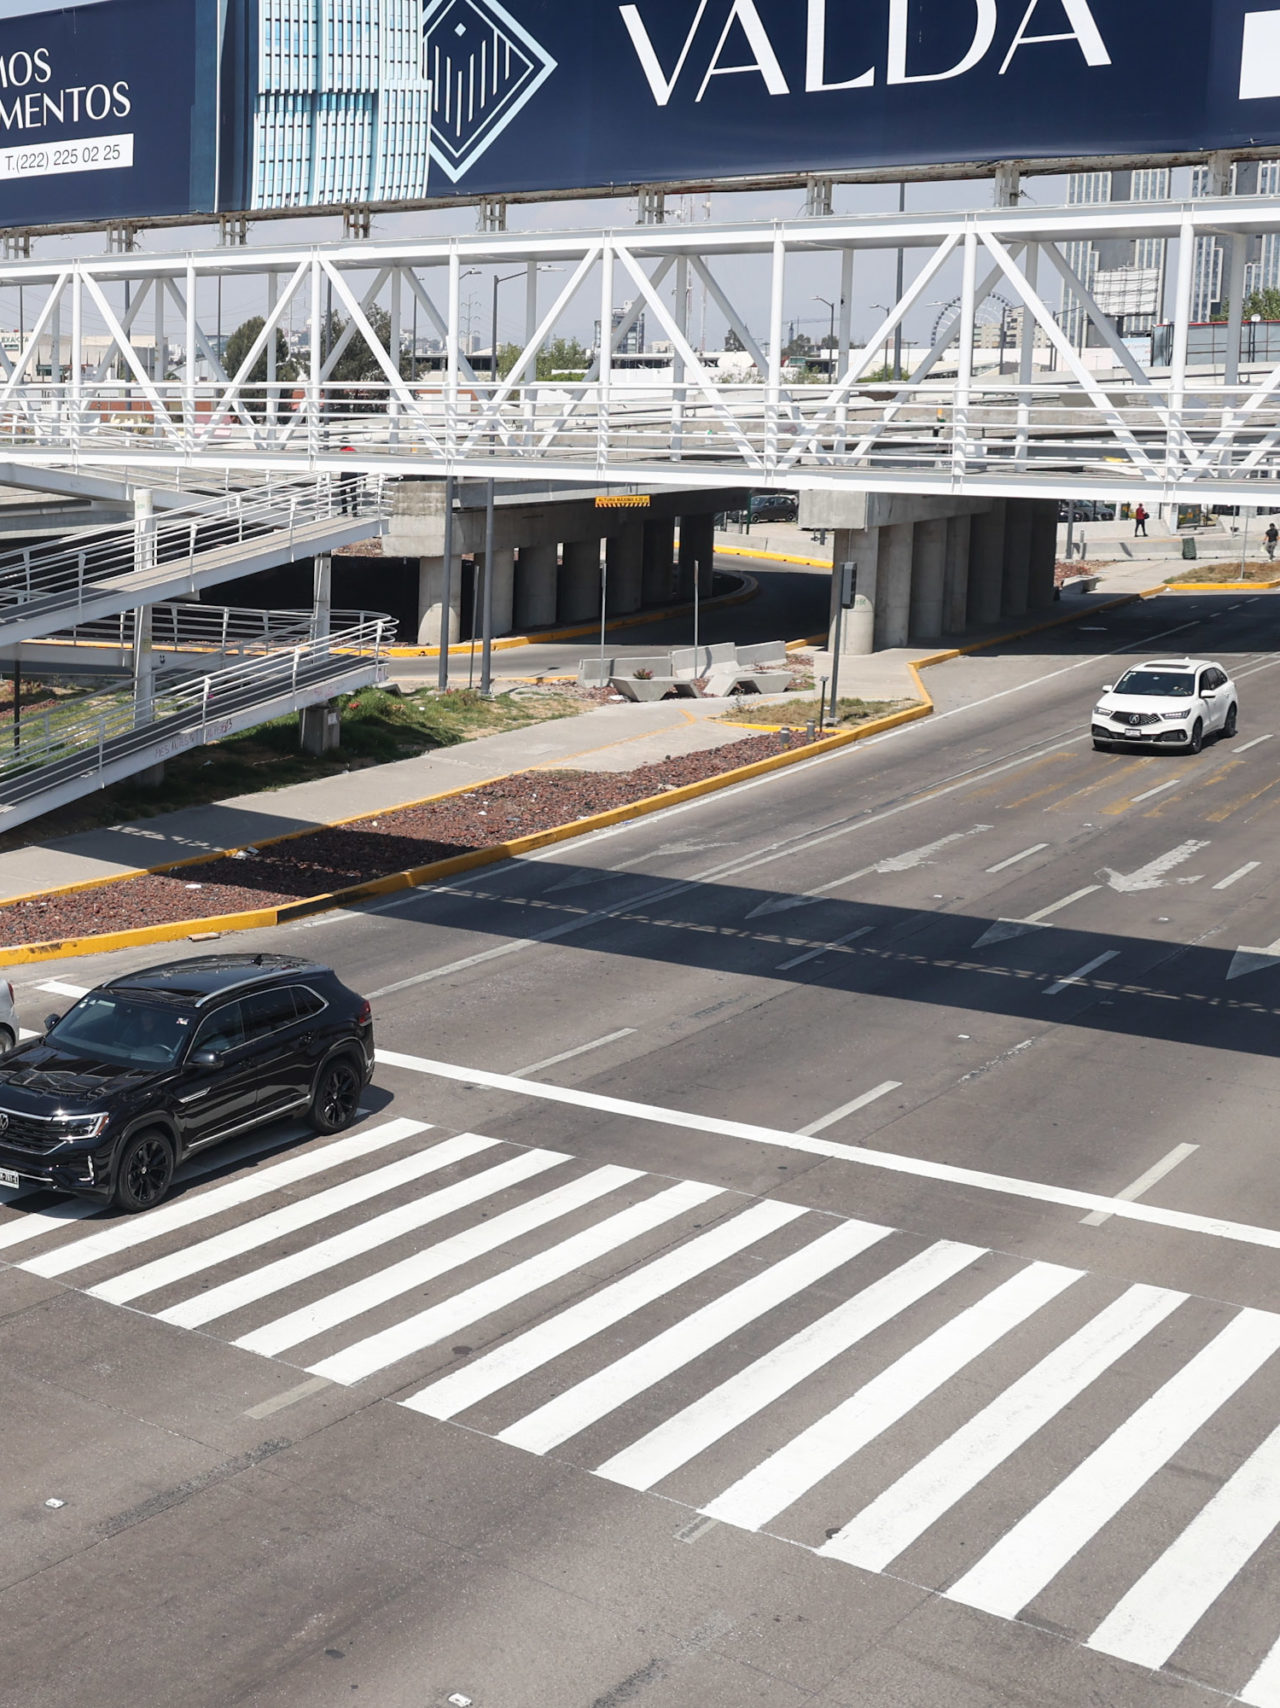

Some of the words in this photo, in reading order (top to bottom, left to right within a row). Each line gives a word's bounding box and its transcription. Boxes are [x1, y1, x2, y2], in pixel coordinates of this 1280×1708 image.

[618, 0, 1112, 106] VALDA
[53, 148, 78, 166] 225
[82, 147, 99, 163] 02
[103, 144, 121, 160] 25
